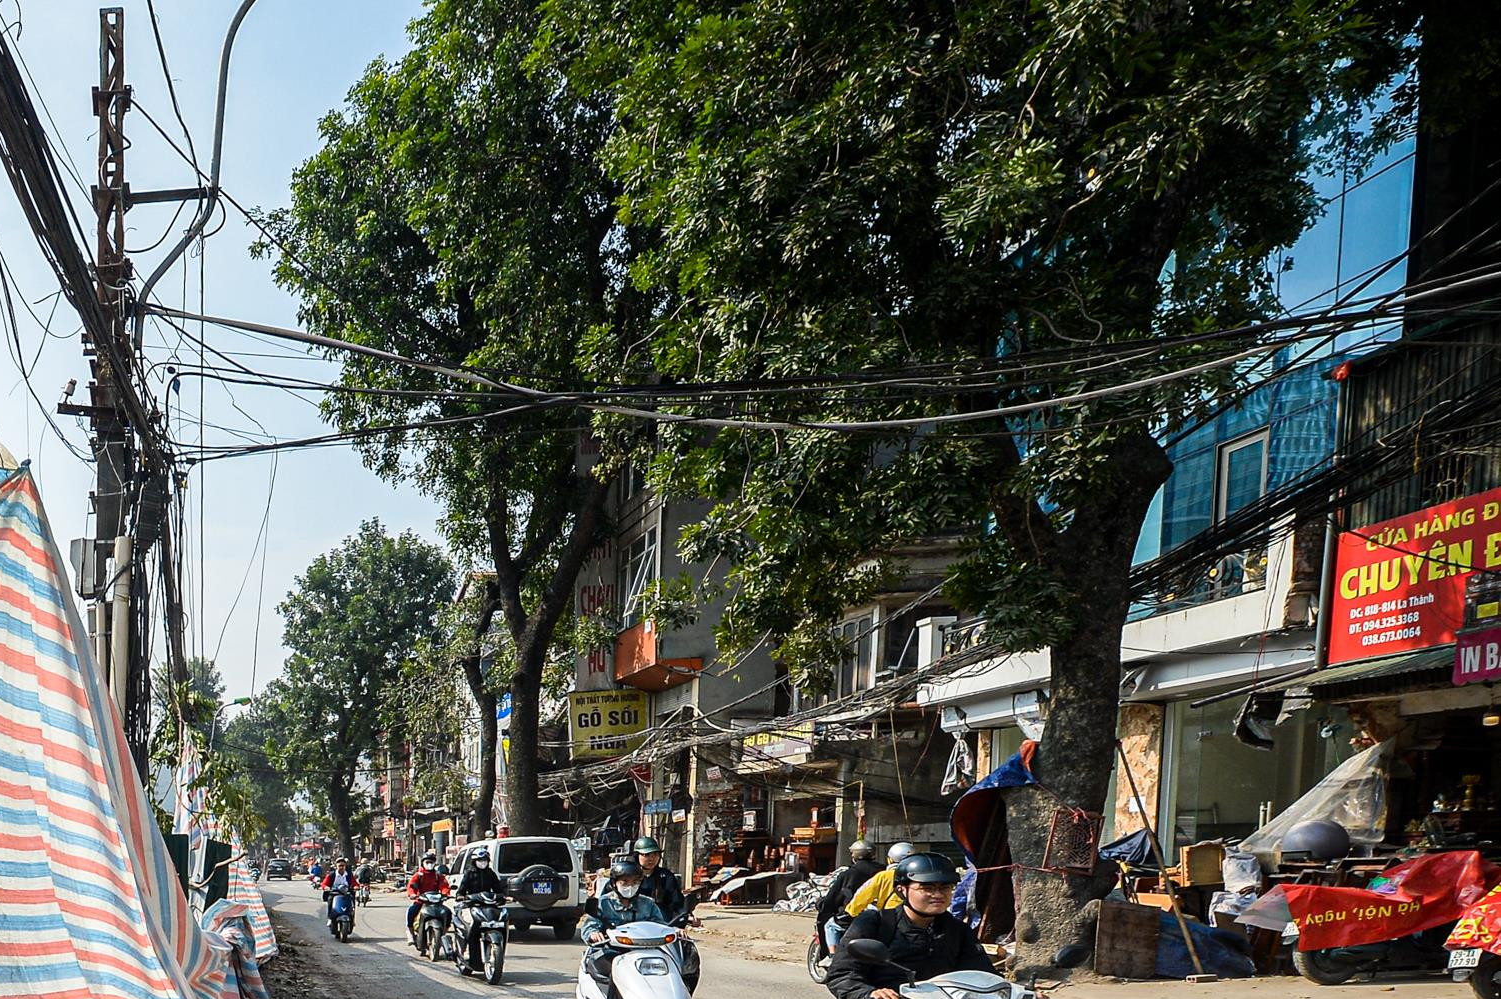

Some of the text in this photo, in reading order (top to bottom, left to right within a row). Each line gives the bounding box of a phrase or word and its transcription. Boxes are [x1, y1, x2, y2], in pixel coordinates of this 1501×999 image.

[1366, 526, 1409, 552] CỬA
[1414, 508, 1475, 540] HÀNG
[1340, 540, 1474, 600] CHUYÊN
[1409, 592, 1435, 607] Thành
[1460, 642, 1501, 674] IN B
[578, 706, 602, 728] GỖ
[590, 733, 628, 750] NGA
[1352, 905, 1392, 921] Nội,
[1397, 900, 1421, 915] Hà
[1305, 909, 1346, 927] ngày
